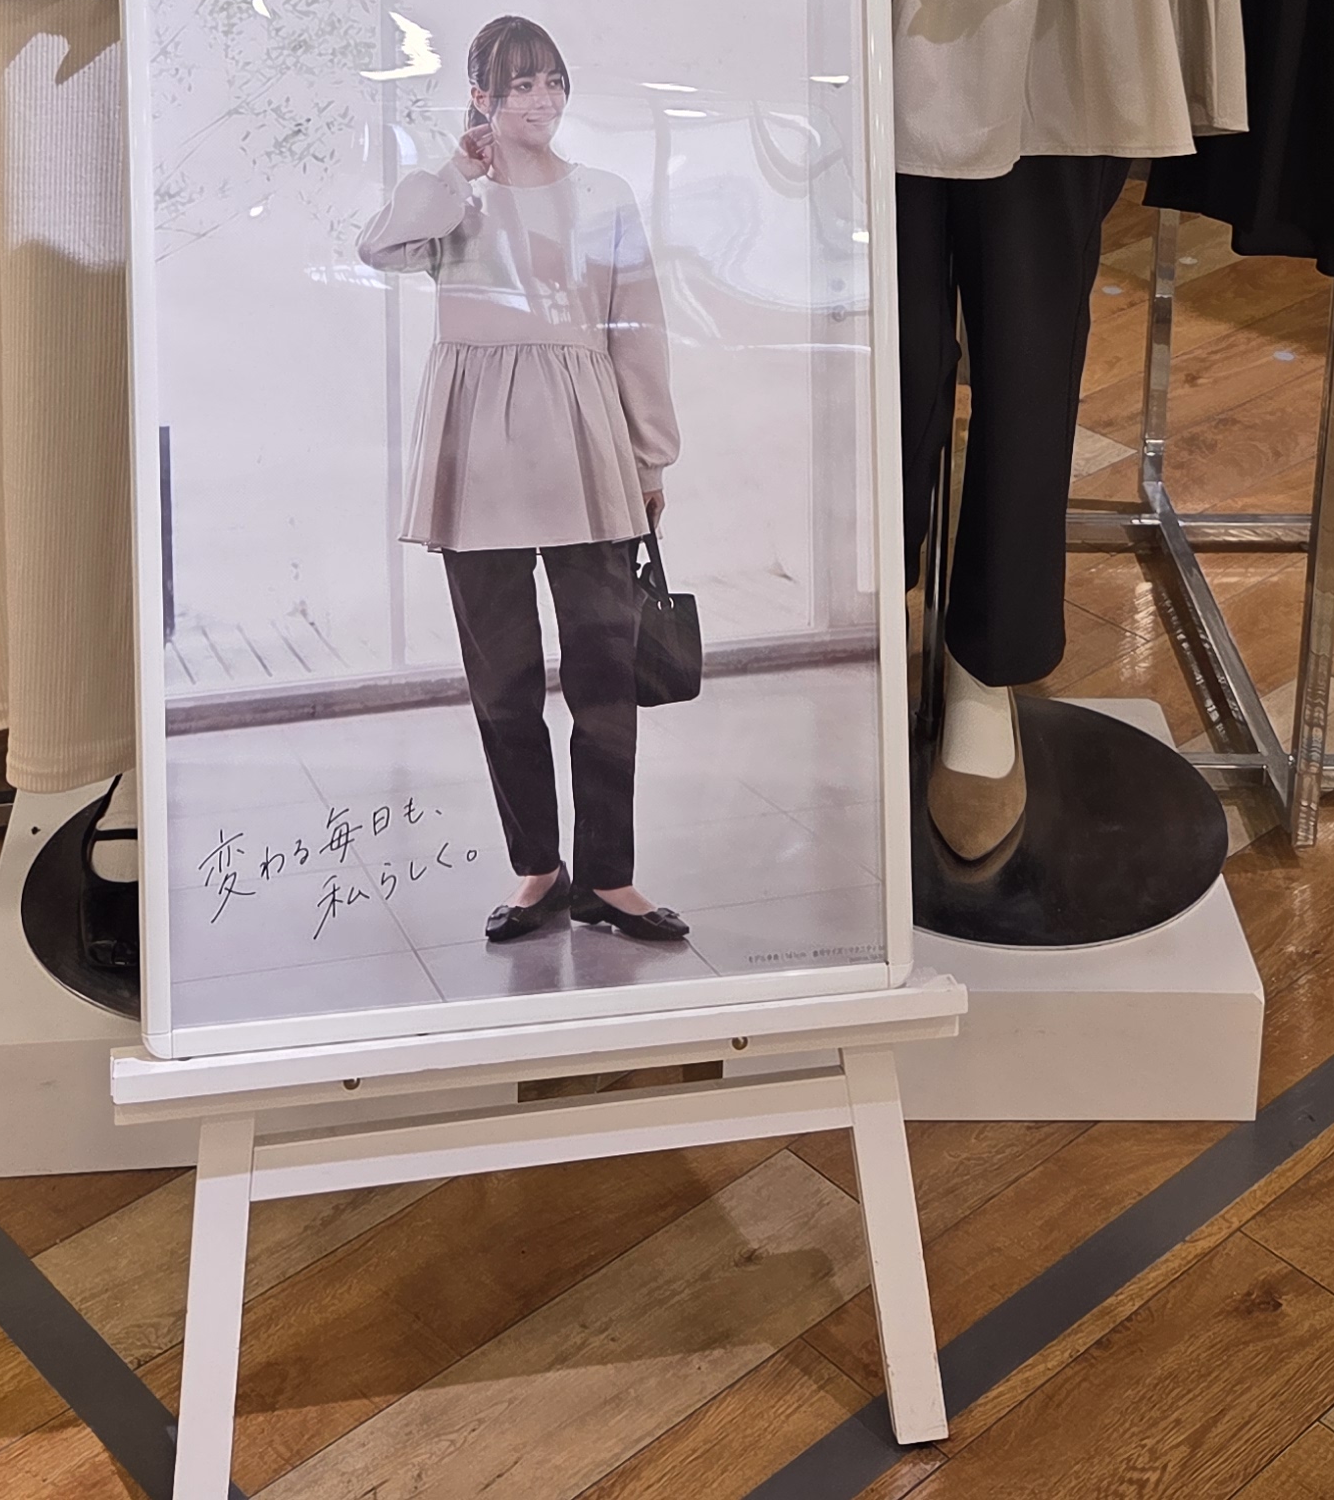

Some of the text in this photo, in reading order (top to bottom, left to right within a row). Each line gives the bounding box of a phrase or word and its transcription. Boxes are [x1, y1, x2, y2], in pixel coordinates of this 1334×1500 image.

[198, 797, 443, 924] 変わる毎日も、
[313, 842, 479, 941] 私らしく。
